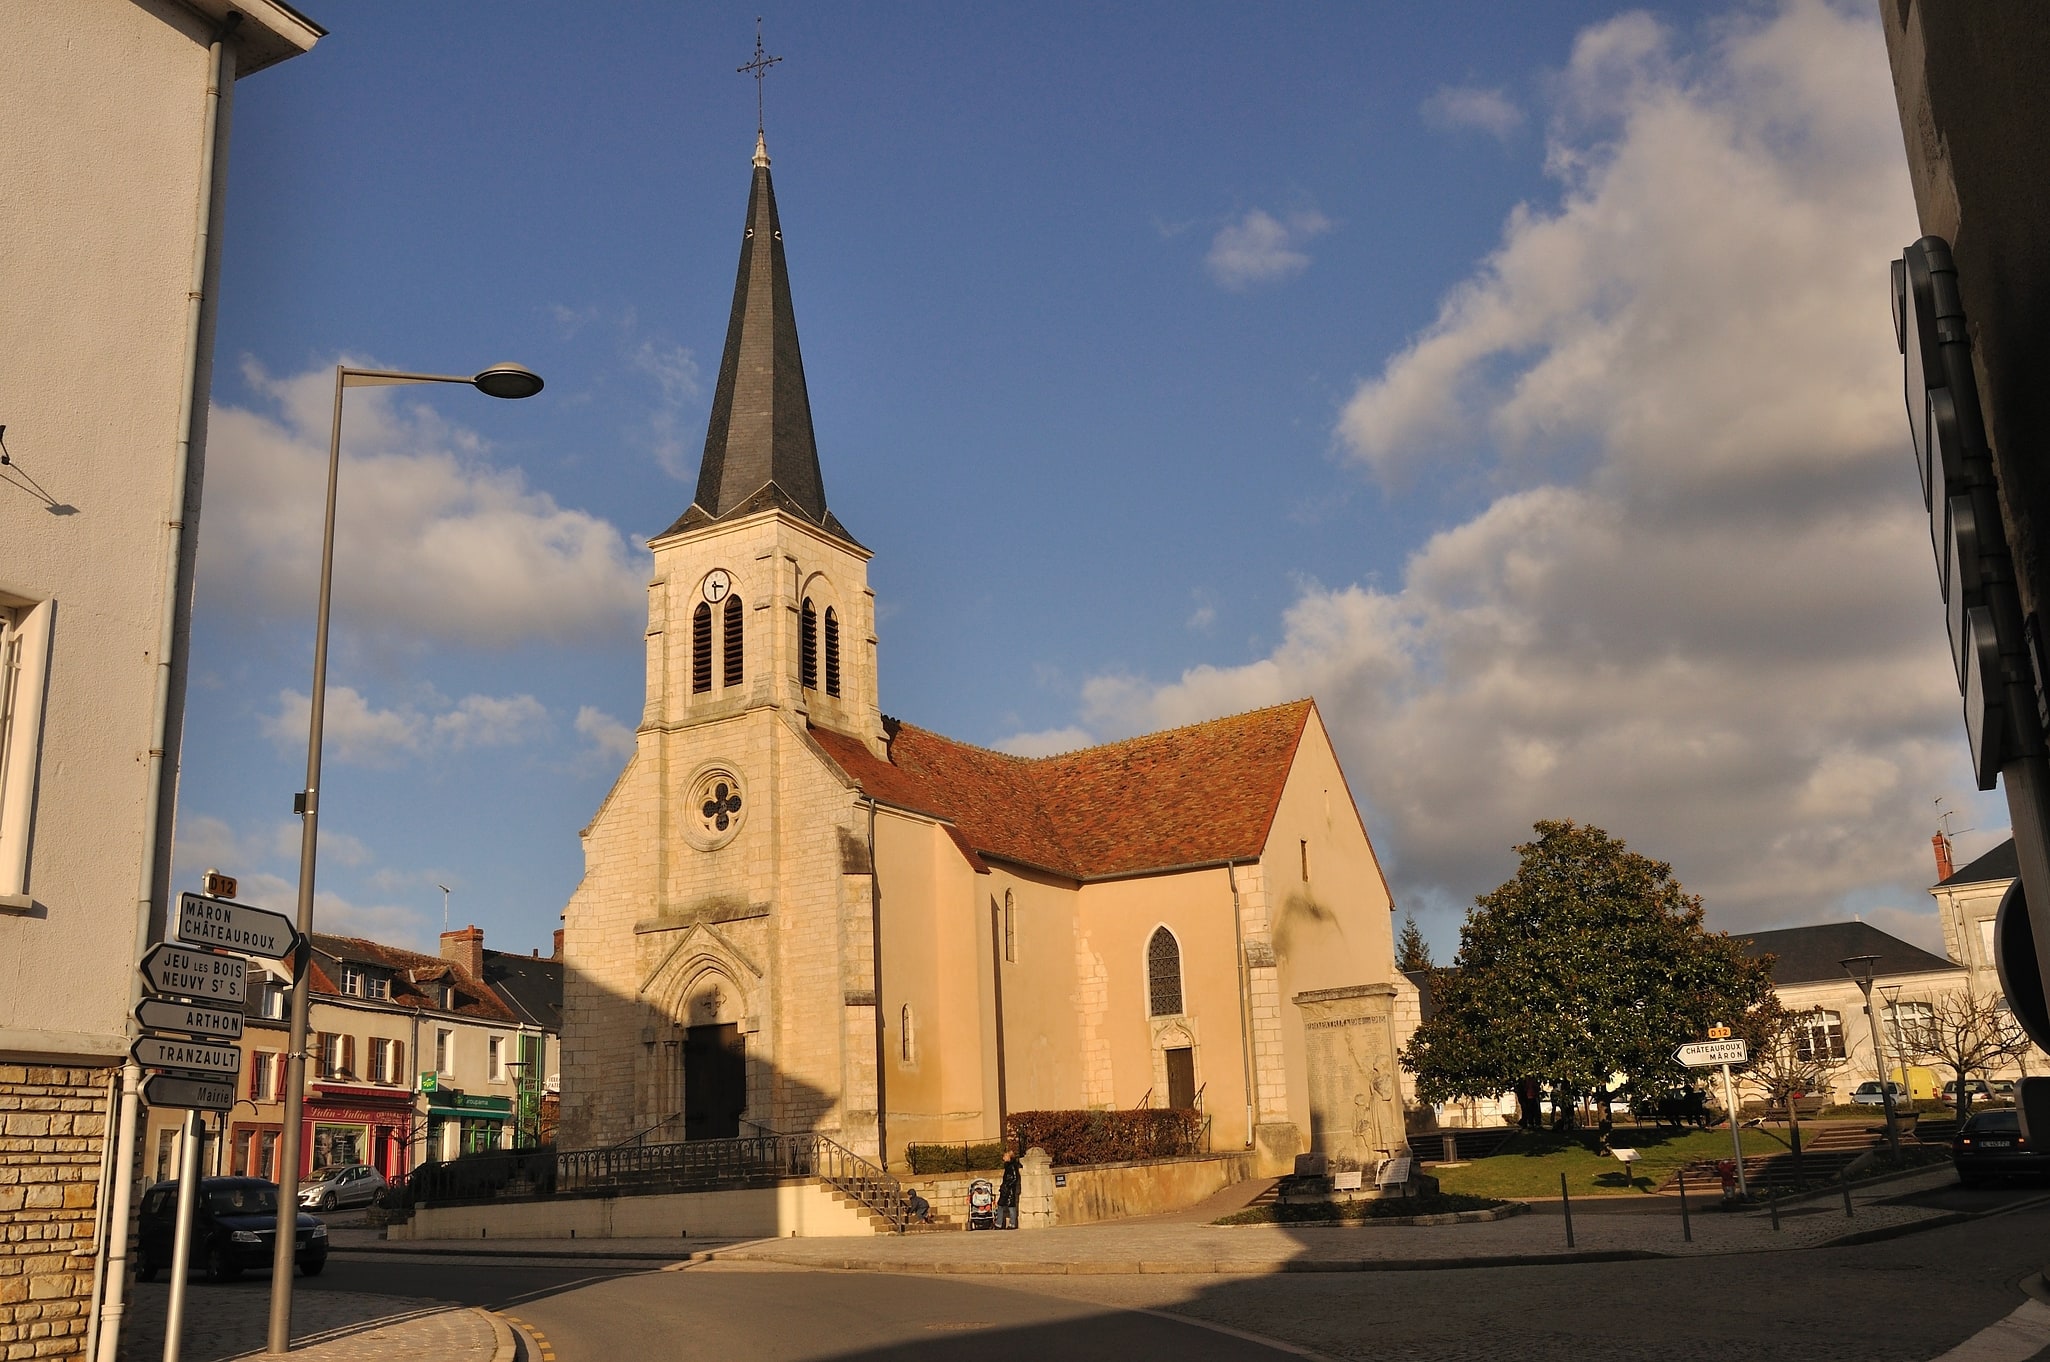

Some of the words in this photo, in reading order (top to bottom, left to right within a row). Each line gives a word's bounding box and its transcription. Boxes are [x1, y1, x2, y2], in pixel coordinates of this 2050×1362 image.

[208, 877, 218, 891] D
[220, 879, 234, 895] 12
[185, 901, 232, 924] MÂRON
[185, 919, 275, 950] CHÂTEAUROUX
[164, 953, 190, 970] JEU
[194, 962, 209, 973] LES
[213, 961, 242, 978] BOIS
[162, 971, 205, 991] NEUVY
[229, 982, 240, 996] S.
[186, 1011, 239, 1031] ARTHON
[1718, 1028, 1728, 1036] 12
[159, 1045, 236, 1067] TRANZAULT
[1686, 1043, 1741, 1054] CHÂTEAUROUX
[1709, 1051, 1742, 1061] MÂRON
[197, 1087, 229, 1104] Mairie
